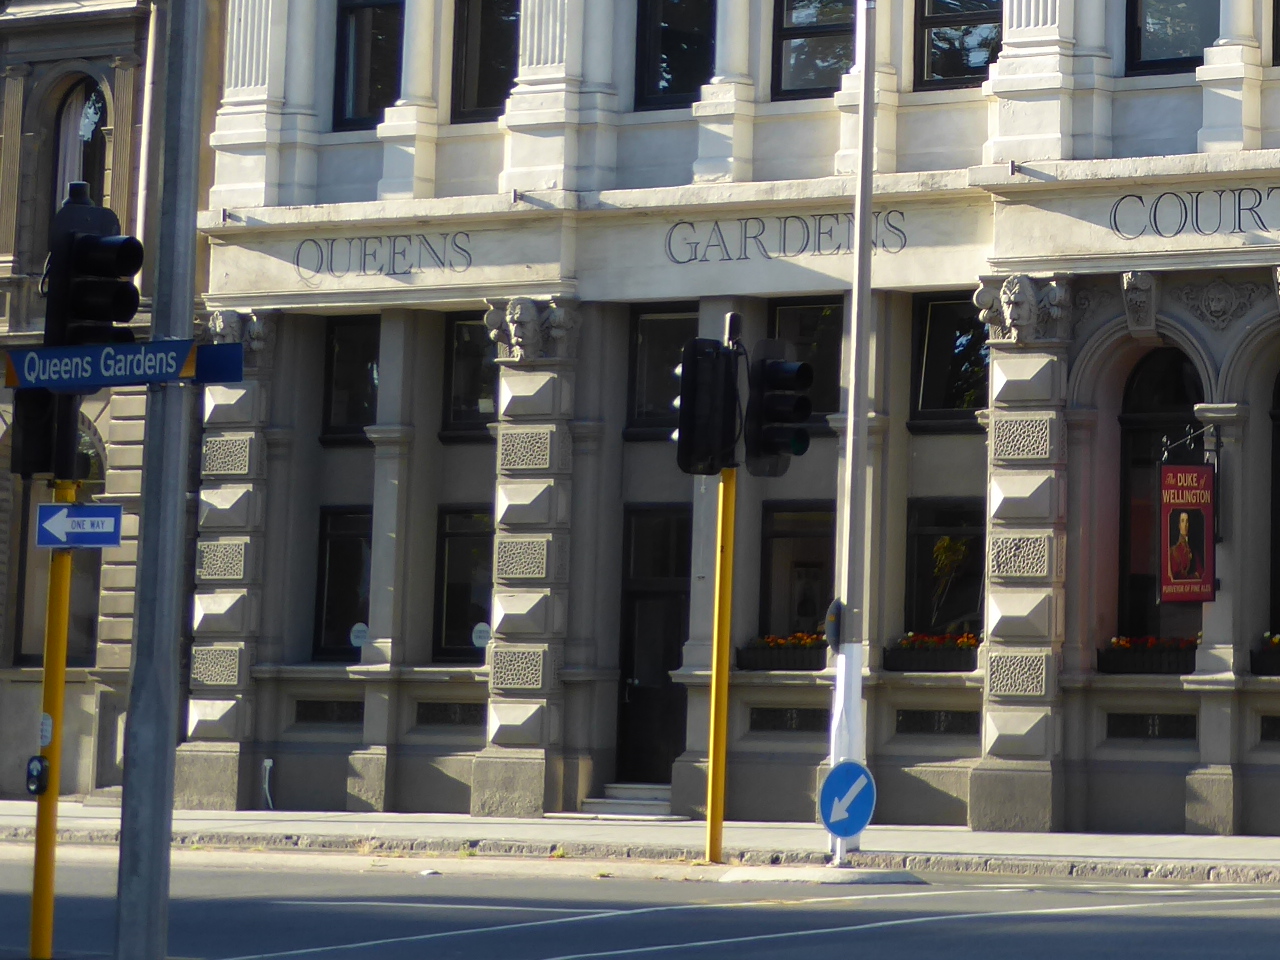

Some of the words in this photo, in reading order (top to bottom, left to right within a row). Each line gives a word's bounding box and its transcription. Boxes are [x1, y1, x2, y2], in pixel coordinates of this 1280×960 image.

[664, 209, 908, 265] GARDENS
[294, 231, 473, 289] QUEENS
[24, 351, 92, 384] Queens
[100, 346, 177, 377] Gardens
[1177, 473, 1198, 487] DUKE
[1199, 474, 1208, 489] of
[1162, 489, 1211, 504] WELLINGTON
[70, 519, 86, 530] ONE
[89, 519, 106, 530] WAY
